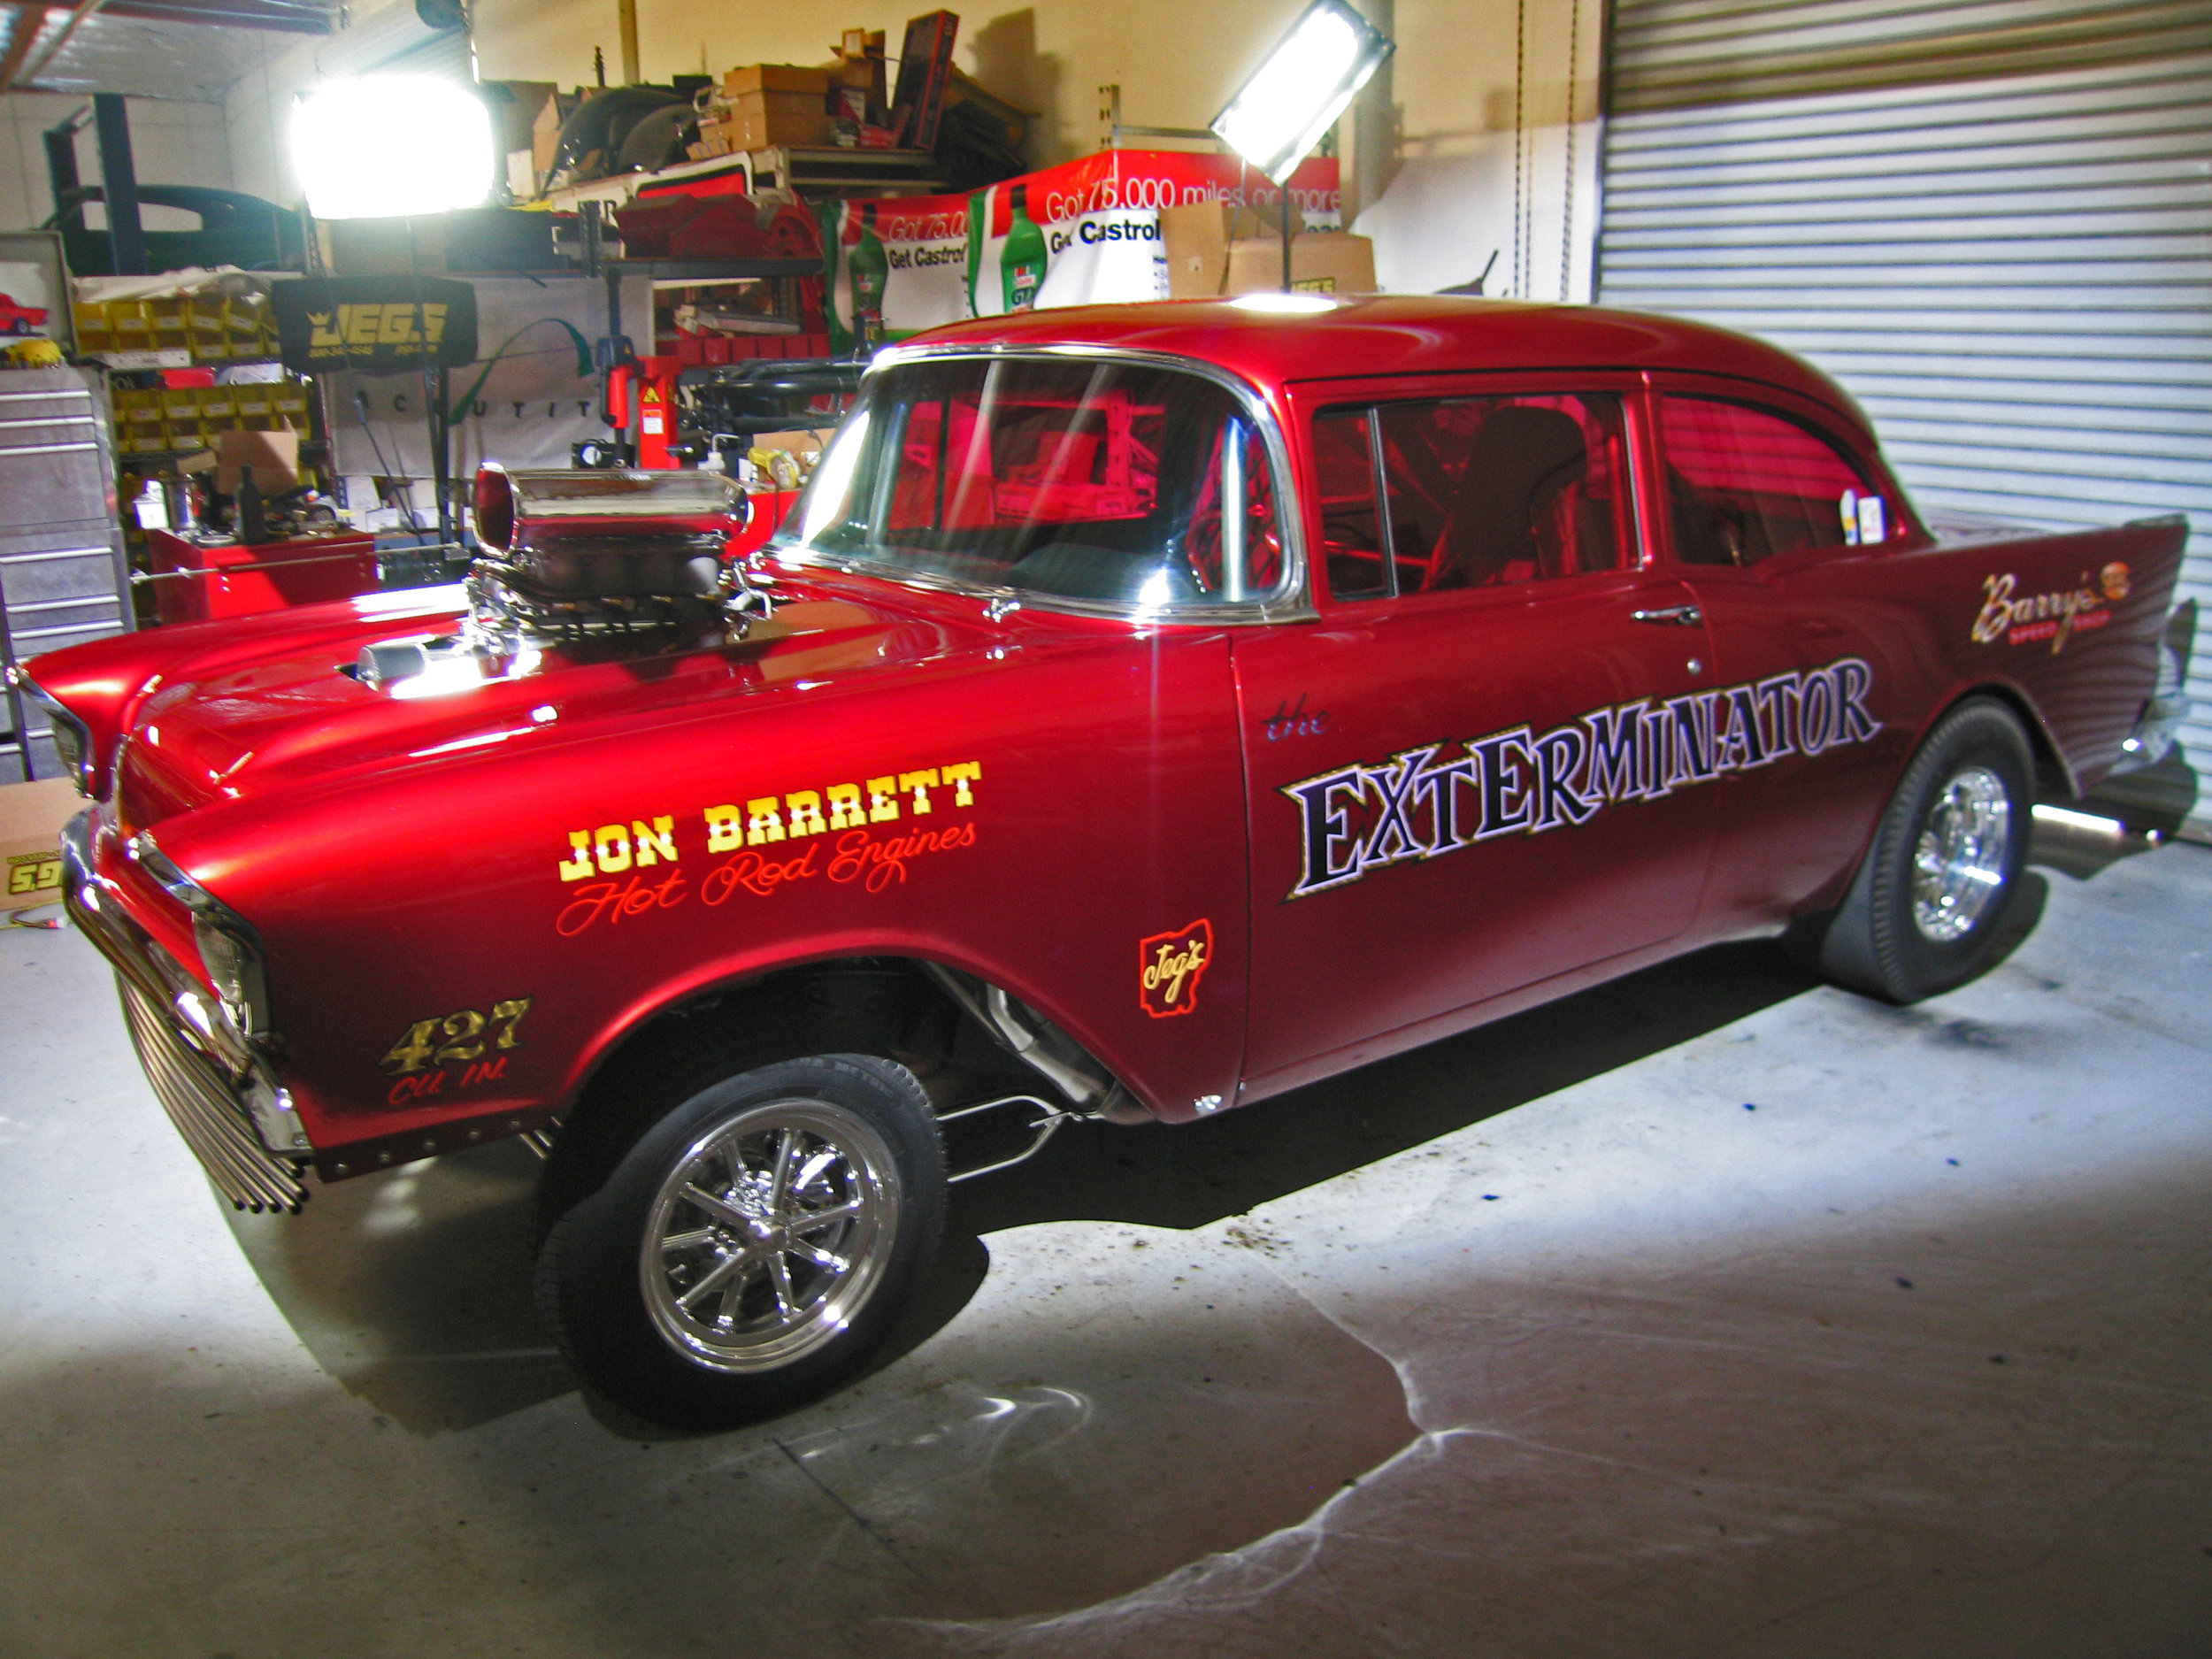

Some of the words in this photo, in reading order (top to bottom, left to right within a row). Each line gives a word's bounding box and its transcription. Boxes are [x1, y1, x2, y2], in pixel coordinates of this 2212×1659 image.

[889, 216, 921, 242] Got
[1046, 188, 1084, 223] Got
[1183, 180, 1245, 208] miles
[889, 249, 912, 269] Get
[914, 242, 967, 267] Castrol
[1079, 219, 1161, 245] Castrol
[311, 303, 448, 347] JEGS
[1971, 572, 2106, 655] Barry's
[1260, 693, 1331, 741] the
[1276, 657, 1883, 902] EXTERMINATOR
[558, 815, 680, 882] JON
[703, 760, 983, 854] BARRETT
[556, 868, 687, 937] Hot
[701, 842, 819, 906] Rod
[827, 822, 977, 894] Engines
[1143, 939, 1206, 1003] Jeg's
[376, 996, 533, 1077] 427
